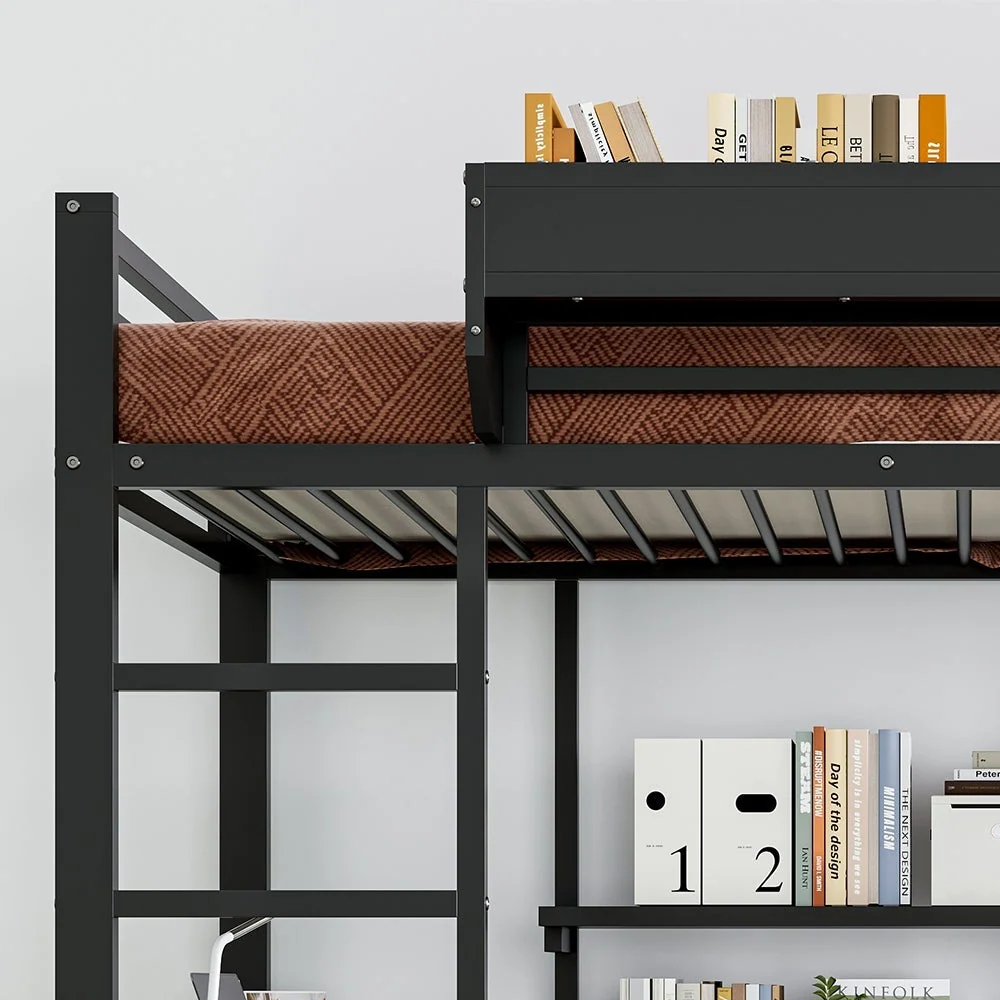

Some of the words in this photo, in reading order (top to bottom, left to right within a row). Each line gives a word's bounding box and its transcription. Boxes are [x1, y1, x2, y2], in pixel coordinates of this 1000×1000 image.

[712, 128, 727, 154] Day
[739, 134, 747, 162] GET
[821, 127, 838, 146] LE
[850, 138, 862, 163] BET
[829, 763, 841, 788] Day
[852, 740, 863, 786] simplicity
[814, 750, 823, 817] #DISRUPTMENOW
[830, 793, 841, 807] of
[854, 800, 863, 808] in
[830, 811, 841, 831] the
[883, 787, 895, 850] MINIMALISM
[852, 812, 863, 860] everything
[670, 846, 695, 892] 1
[755, 846, 783, 892] 2
[829, 836, 841, 879] design
[854, 864, 861, 877] we
[838, 986, 935, 1000] KINFOLK
